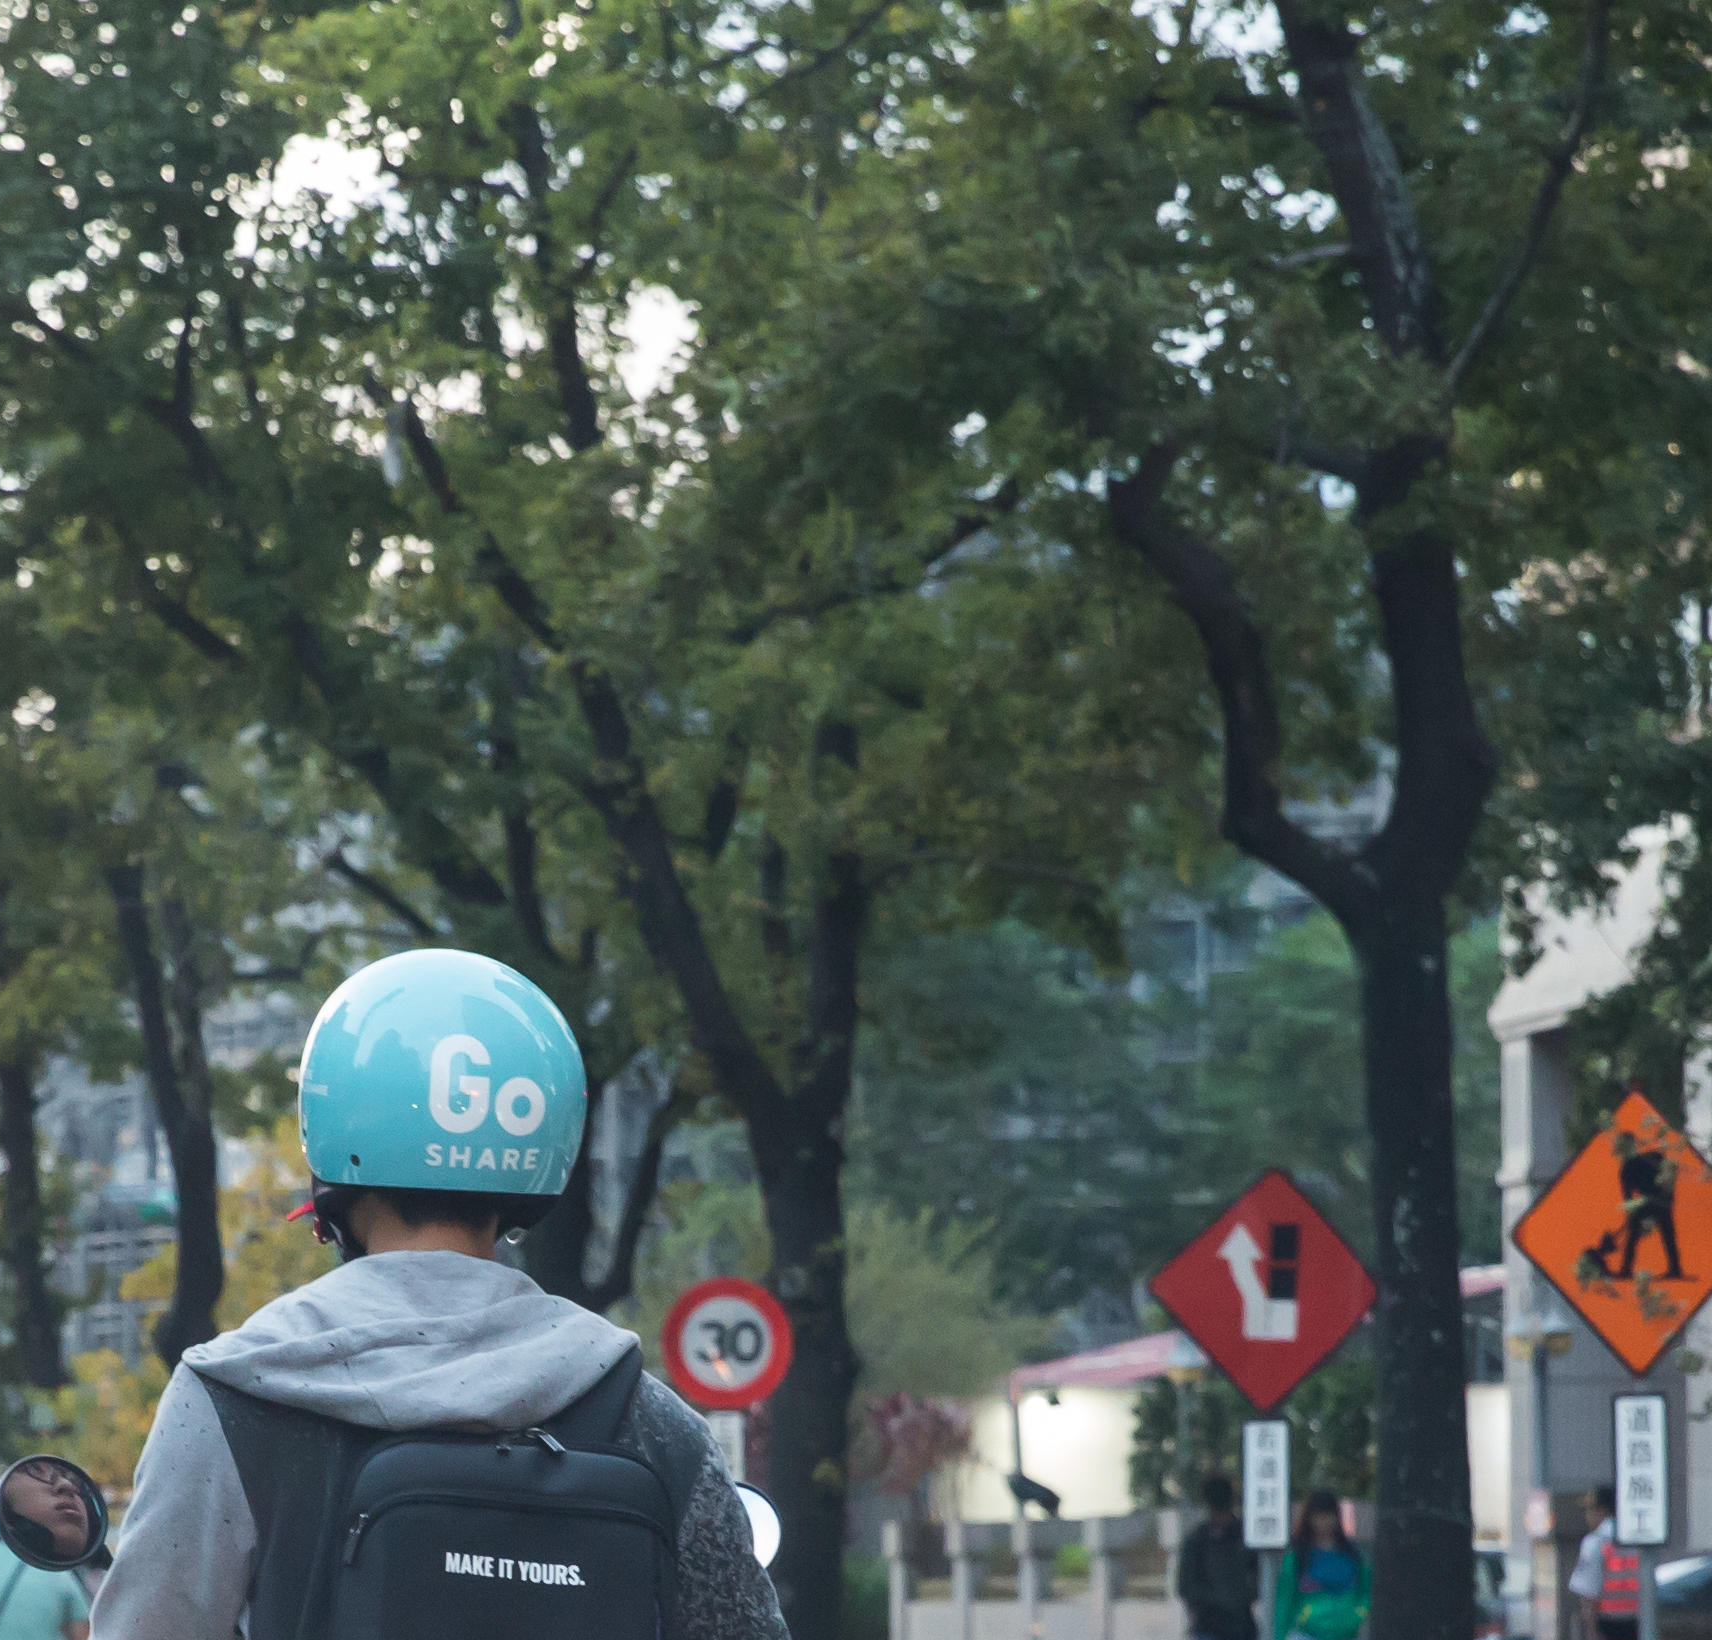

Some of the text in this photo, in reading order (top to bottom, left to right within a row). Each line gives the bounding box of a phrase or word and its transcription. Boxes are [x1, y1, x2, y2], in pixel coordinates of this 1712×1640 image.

[429, 1034, 547, 1136] Go
[424, 1143, 541, 1170] SHARE
[695, 1321, 764, 1363] 30
[445, 1552, 585, 1586] MAKE IT YOURS.
